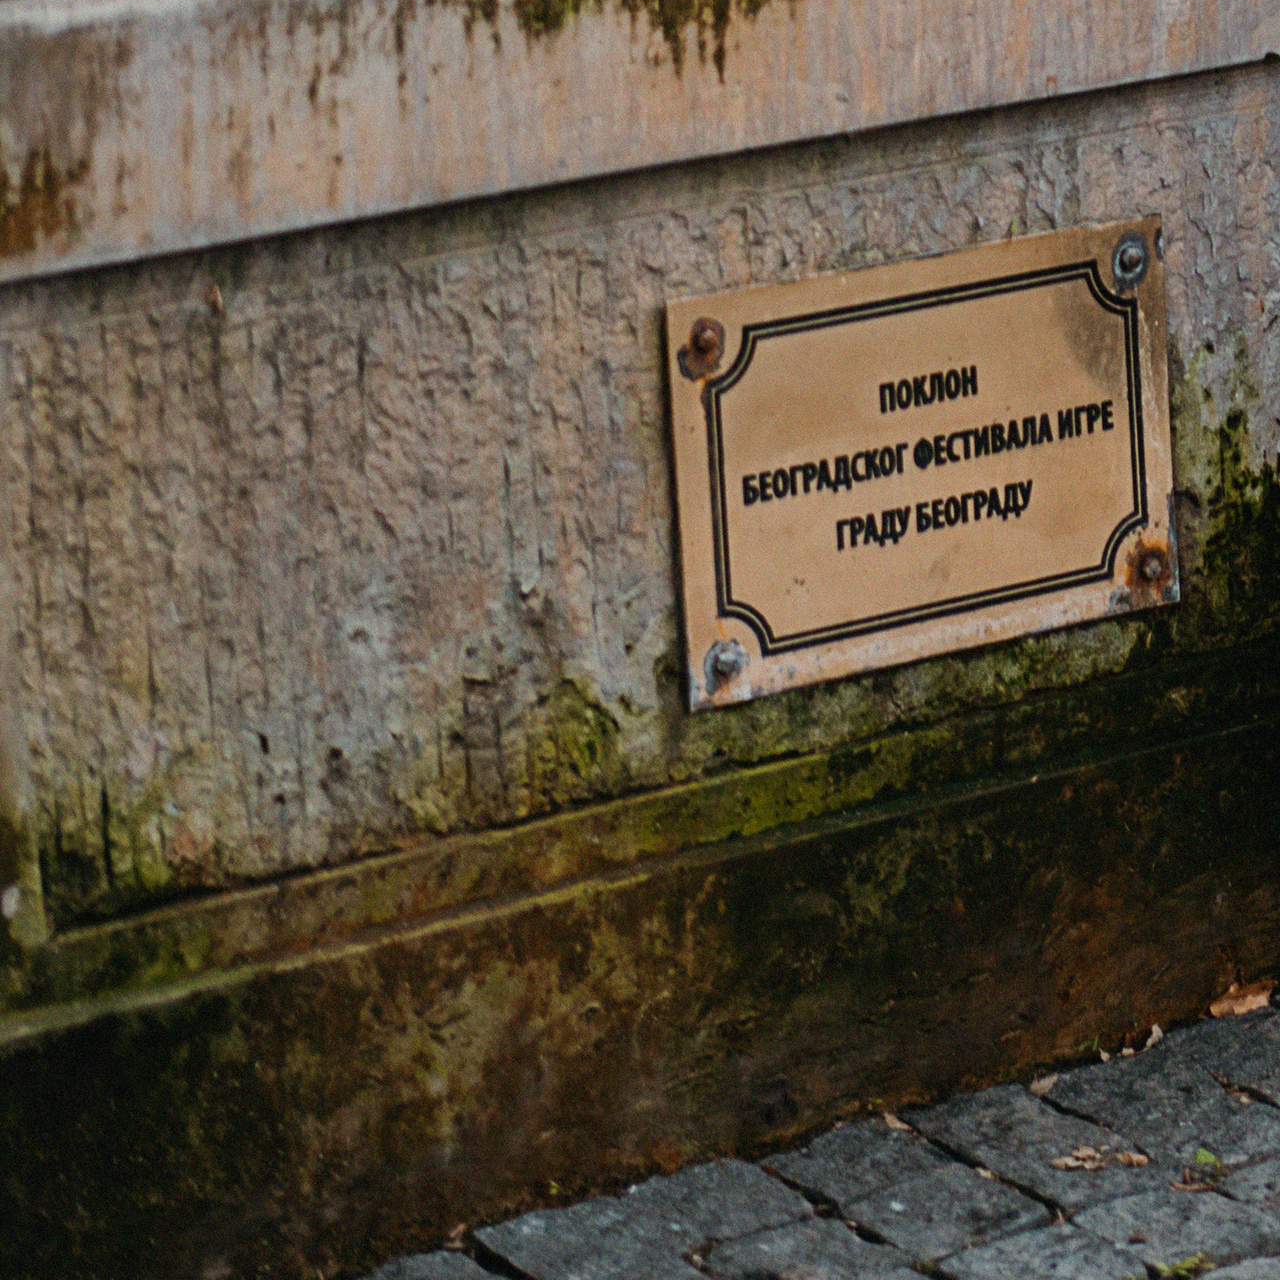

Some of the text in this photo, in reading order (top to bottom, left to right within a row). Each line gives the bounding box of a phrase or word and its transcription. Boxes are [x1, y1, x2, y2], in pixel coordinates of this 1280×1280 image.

[878, 365, 979, 413] ПОКЛОН
[741, 400, 1114, 507] БЕОГРАДСКОГ ФЕСТИВАЛА ИГРЕ
[836, 479, 1034, 551] ГРАДУ БЕОГРАДУ
